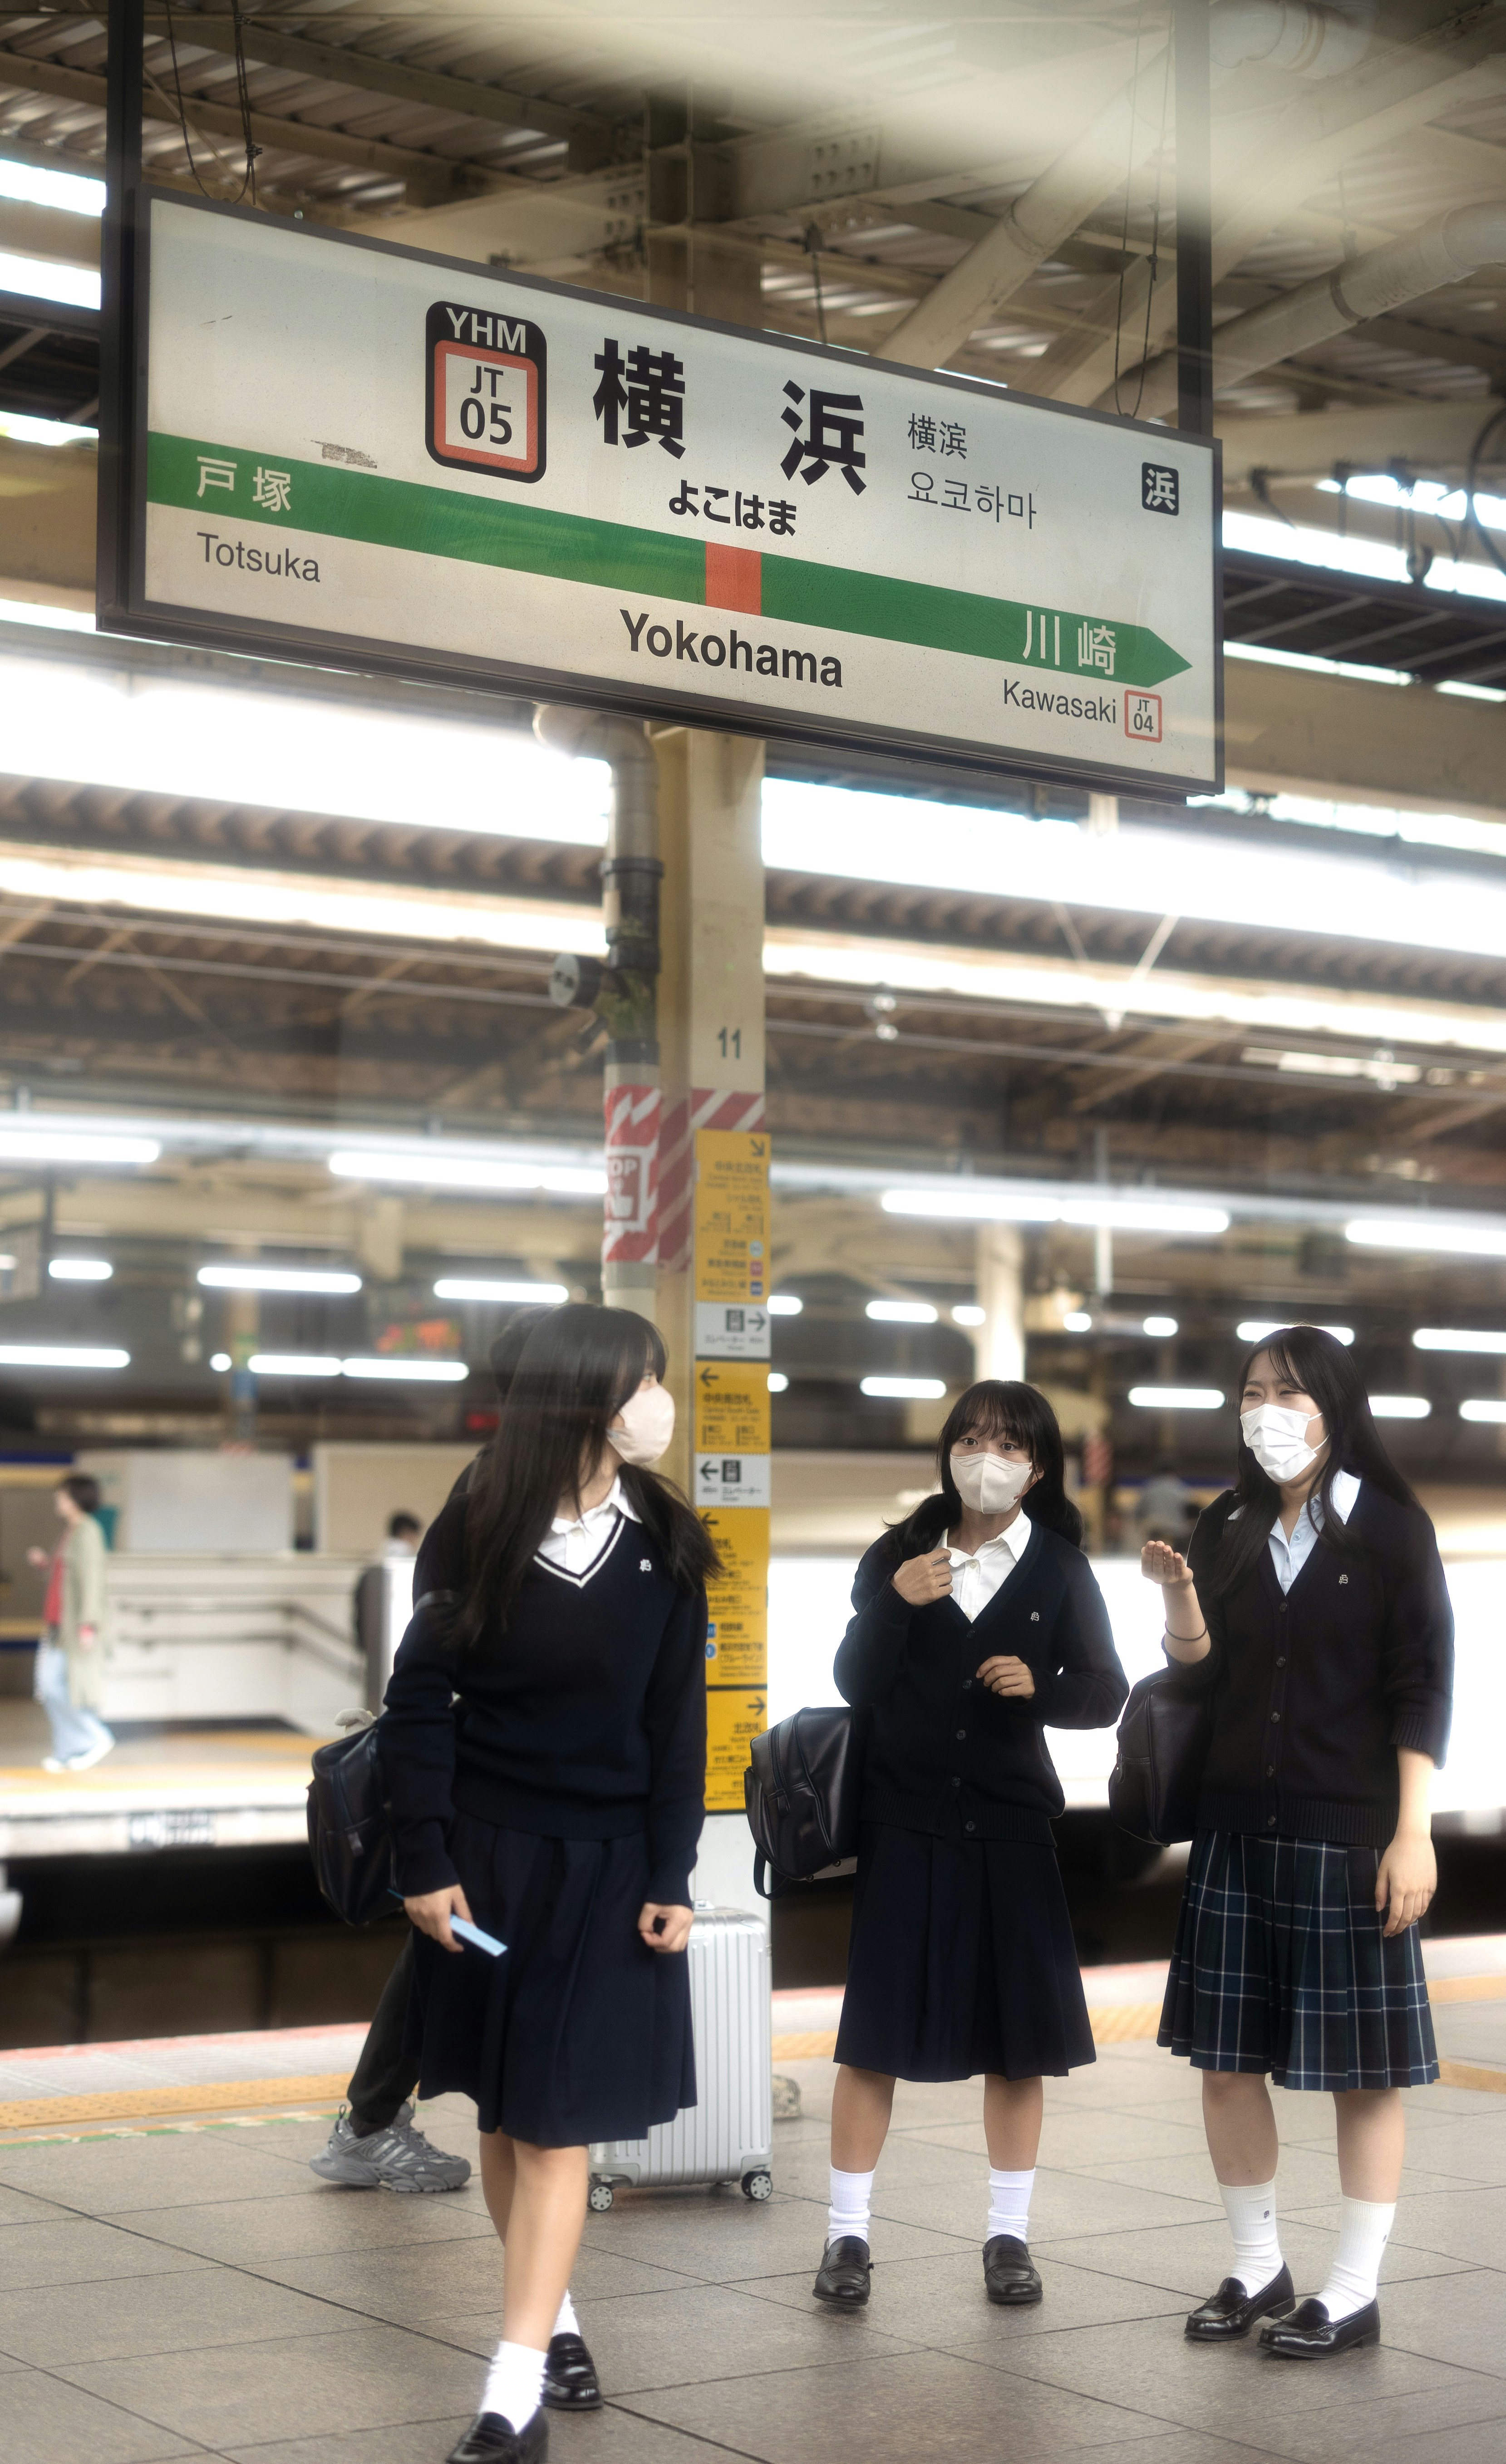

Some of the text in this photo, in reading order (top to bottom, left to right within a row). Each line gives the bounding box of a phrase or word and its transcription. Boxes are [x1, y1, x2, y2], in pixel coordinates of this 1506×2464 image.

[447, 308, 525, 353] YHM
[471, 366, 503, 397] JT
[460, 398, 512, 444] 05
[907, 413, 967, 459] 横滨
[197, 456, 291, 511] 戸塚
[907, 472, 1037, 529] 오코하마
[1145, 468, 1176, 511] 浜
[669, 479, 797, 536] よこはま
[197, 532, 320, 582] Totsuka
[620, 610, 842, 688] Yokohama
[1023, 610, 1116, 675] 川崎
[1004, 679, 1116, 724] Kawasaki
[1133, 713, 1154, 733] 04
[1137, 699, 1150, 712] JT
[717, 1026, 741, 1059] 11
